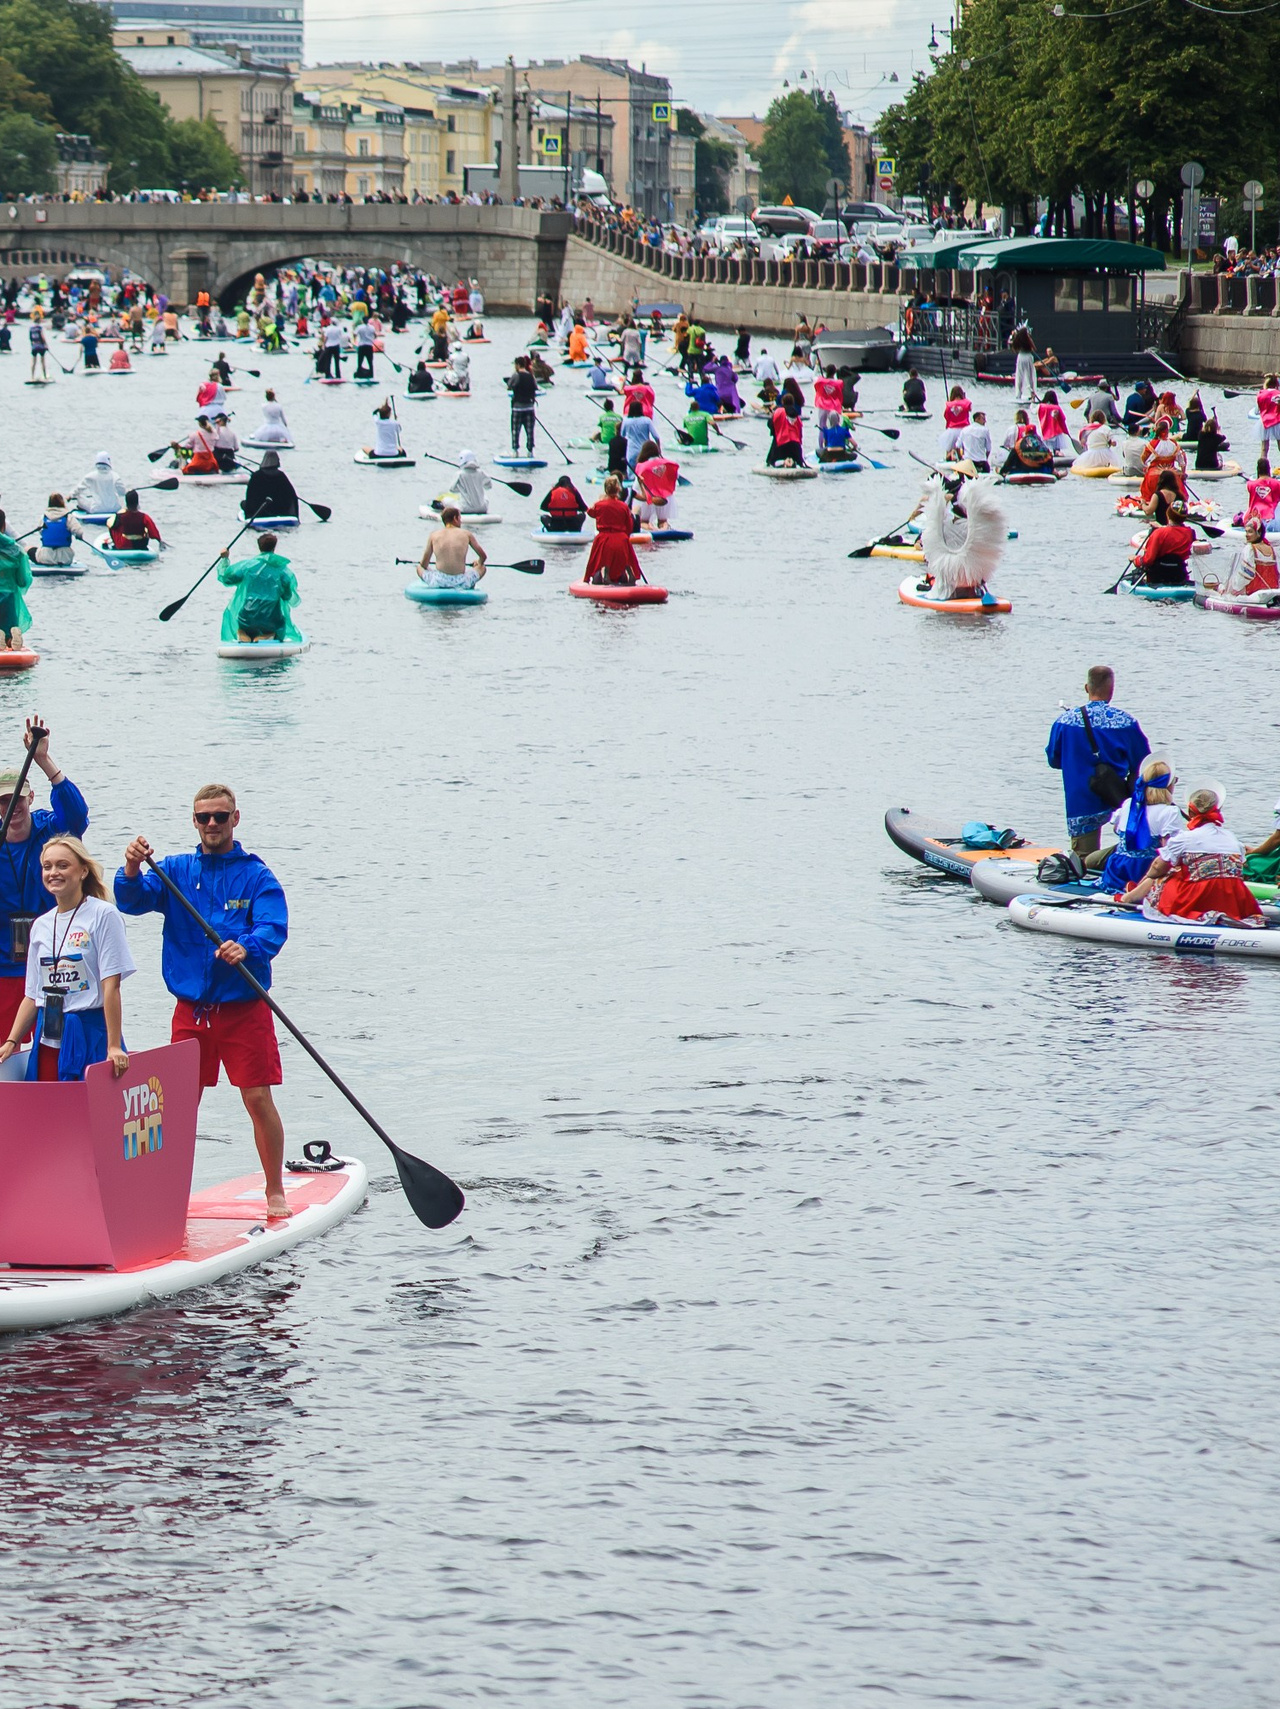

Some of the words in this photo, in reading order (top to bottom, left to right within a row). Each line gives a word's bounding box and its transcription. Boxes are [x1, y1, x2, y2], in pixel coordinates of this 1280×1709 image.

[1180, 935, 1263, 949] HYDRO-FORCE
[48, 970, 81, 984] 02122
[122, 1083, 159, 1120] УТРО
[123, 1112, 163, 1161] ТНТ
